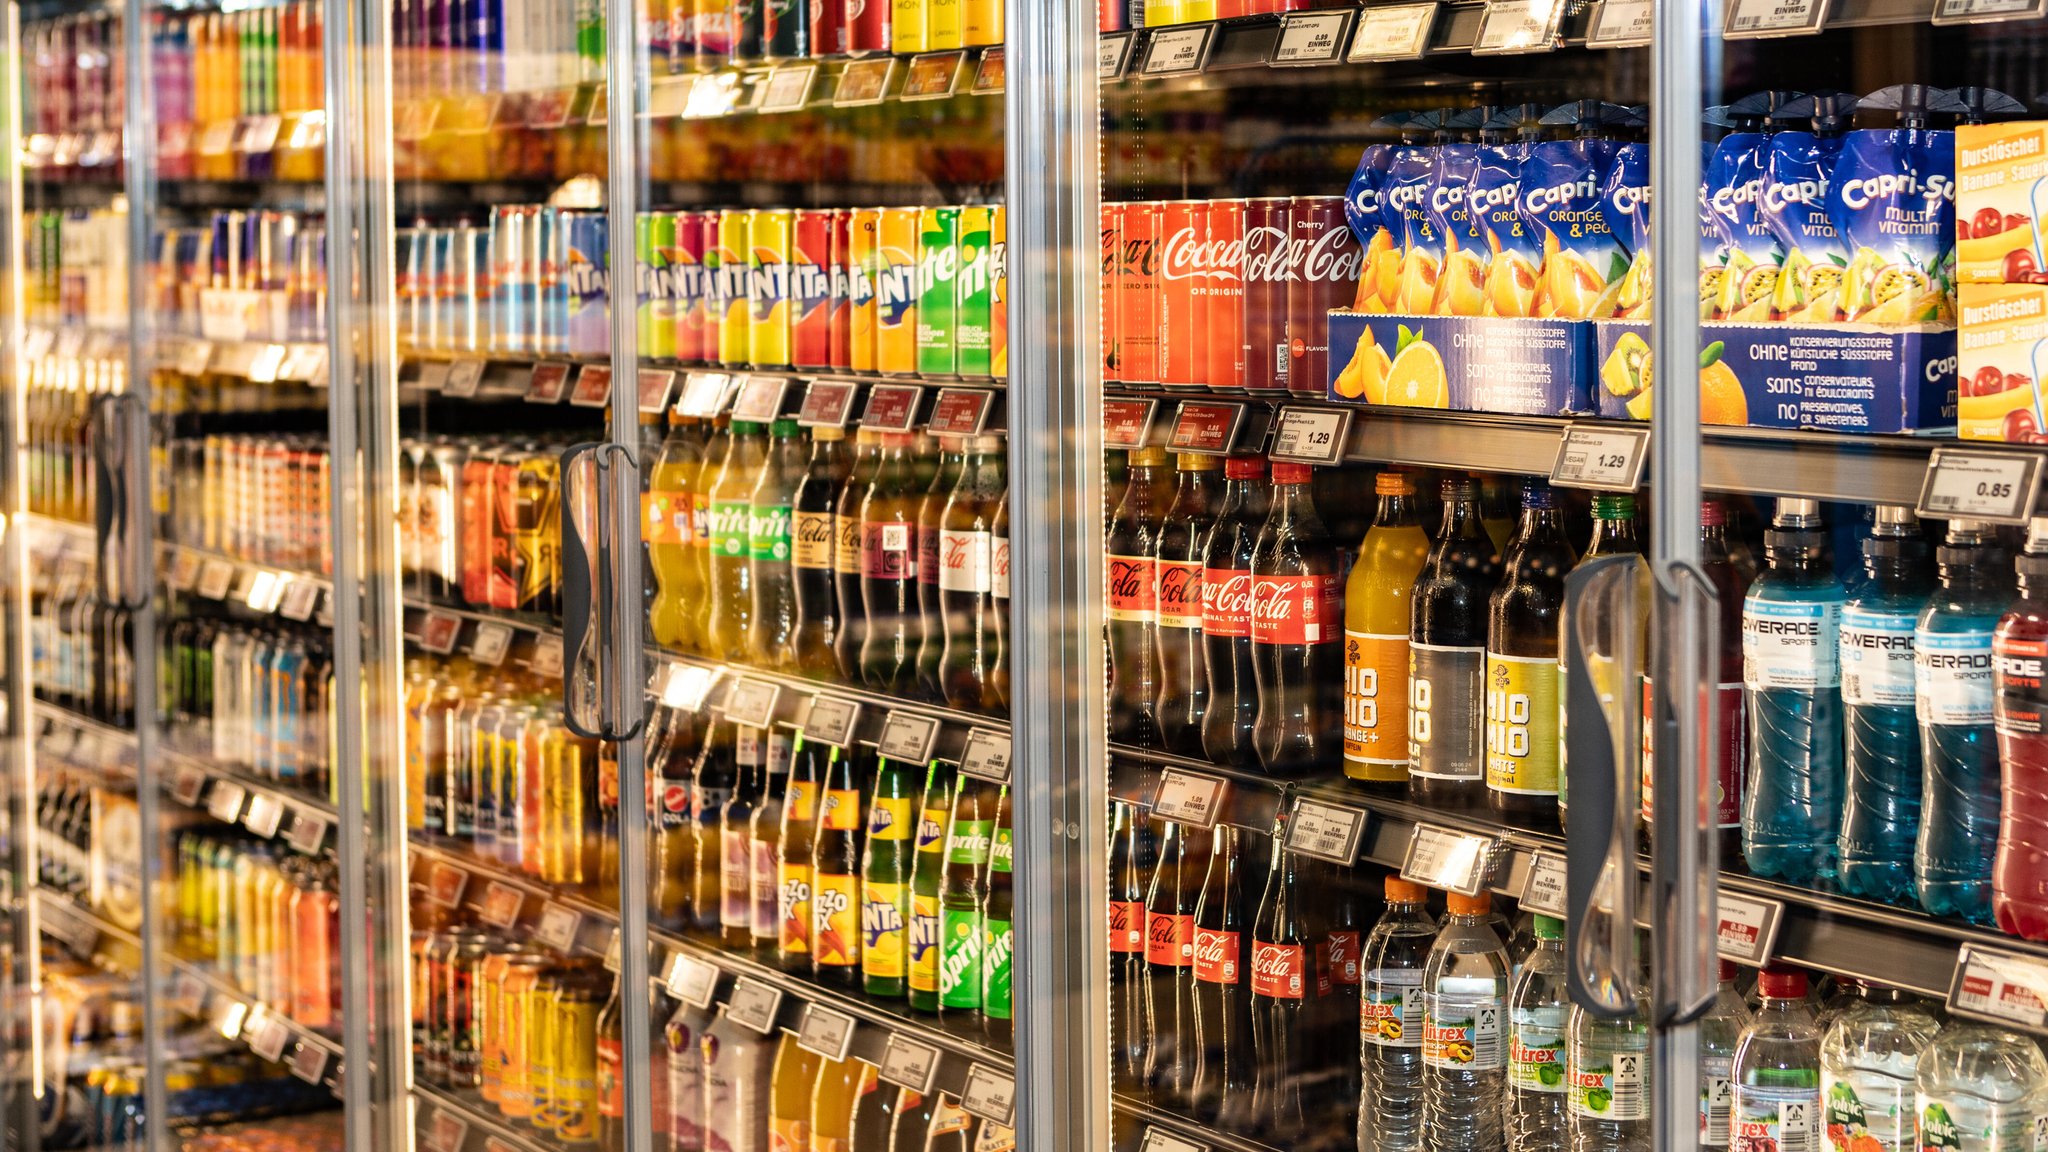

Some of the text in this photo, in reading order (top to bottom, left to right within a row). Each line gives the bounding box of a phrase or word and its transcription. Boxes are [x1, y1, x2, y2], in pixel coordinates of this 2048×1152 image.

[1774, 6, 1806, 15] EINWEG
[1174, 52, 1195, 60] EINWEG
[1961, 134, 2041, 170] Durstlöscher
[1296, 220, 1325, 230] Cherry
[1962, 296, 2042, 326] Durstlöscher
[1116, 425, 1136, 433] EINWEG
[1200, 430, 1222, 438] EINWEG
[1281, 432, 1298, 441] VEGAN
[1307, 431, 1330, 445] 1.29
[1565, 455, 1585, 464] VEGAN
[1598, 453, 1626, 469] 1.29
[1976, 482, 2012, 498] 0.85
[1255, 621, 1278, 630] TASTE
[1780, 637, 1818, 646] SPORTS
[1489, 757, 1517, 774] MATE
[1184, 801, 1206, 811] EINWEG
[1323, 831, 1346, 840] MEHRWEG
[1730, 922, 1748, 933] 0.99
[1720, 928, 1753, 943] EINWEG
[1255, 945, 1295, 977] Cola
[1259, 975, 1278, 984] TASTE
